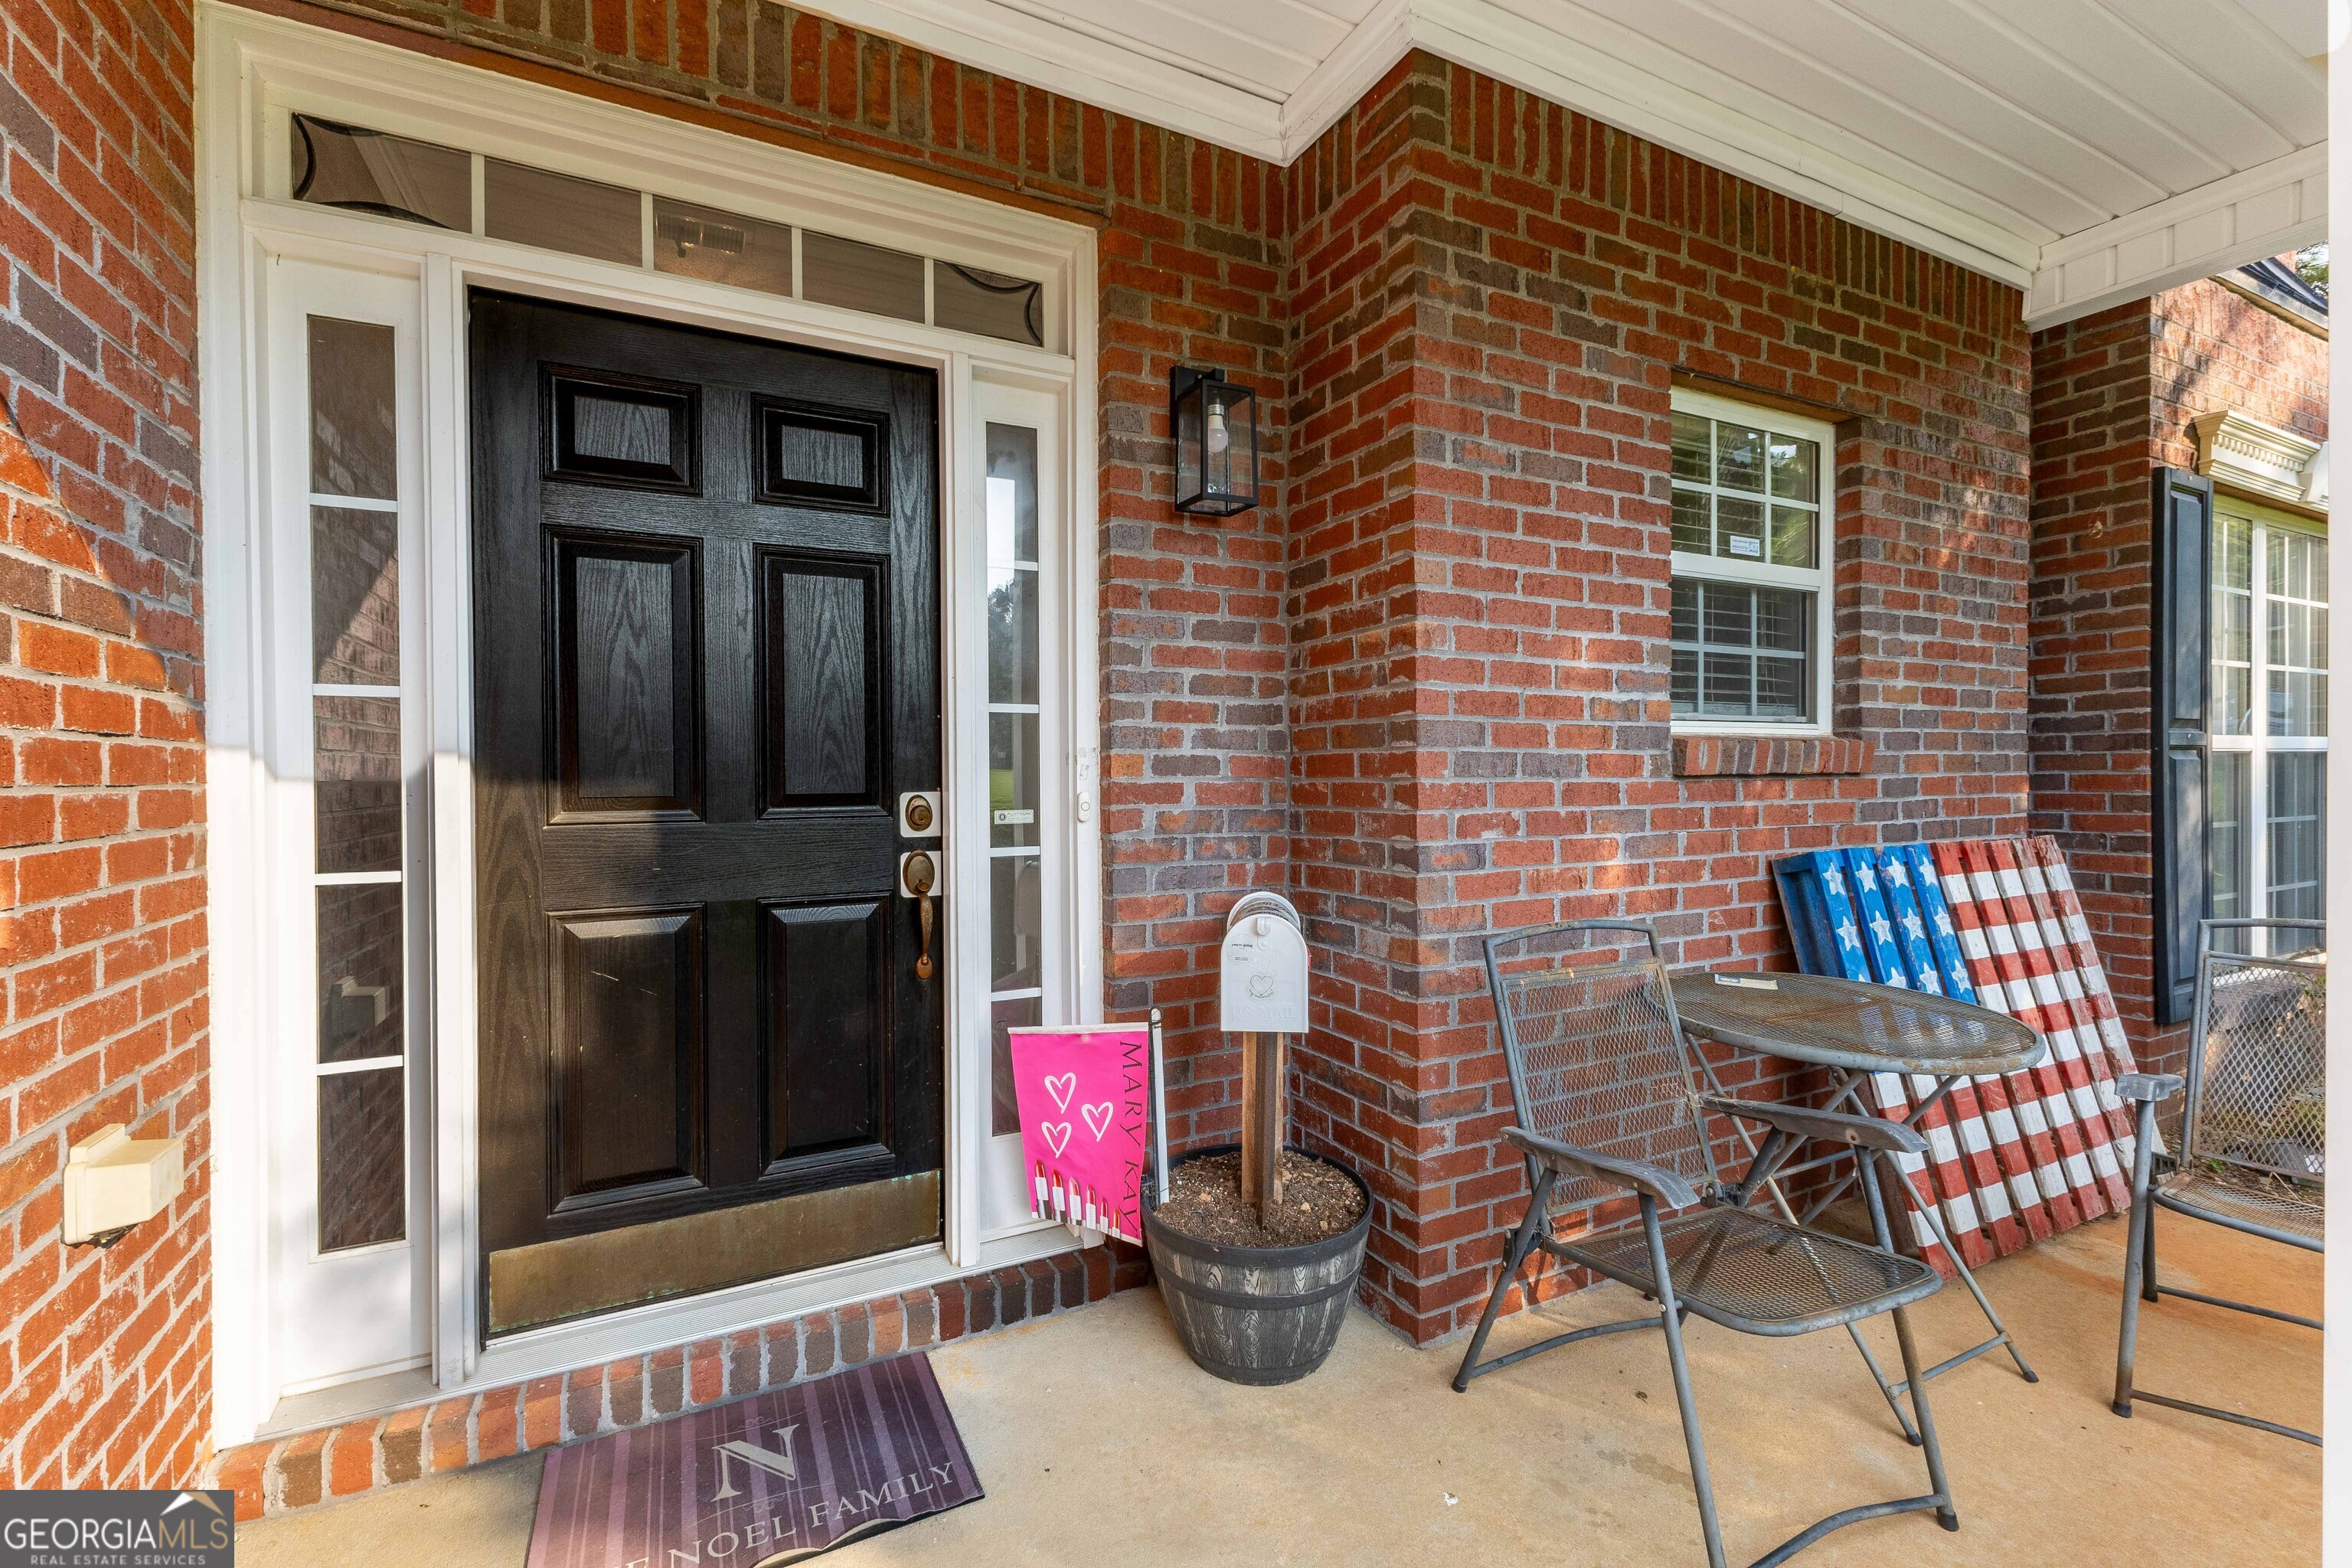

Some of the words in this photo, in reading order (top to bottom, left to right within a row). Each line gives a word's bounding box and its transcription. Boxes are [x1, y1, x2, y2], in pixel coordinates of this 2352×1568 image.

[1119, 1040, 1143, 1148] MARY
[1119, 1159, 1139, 1238] KAY
[710, 1424, 802, 1502] N
[668, 1515, 797, 1568] NOEL
[808, 1461, 953, 1528] FAMILY
